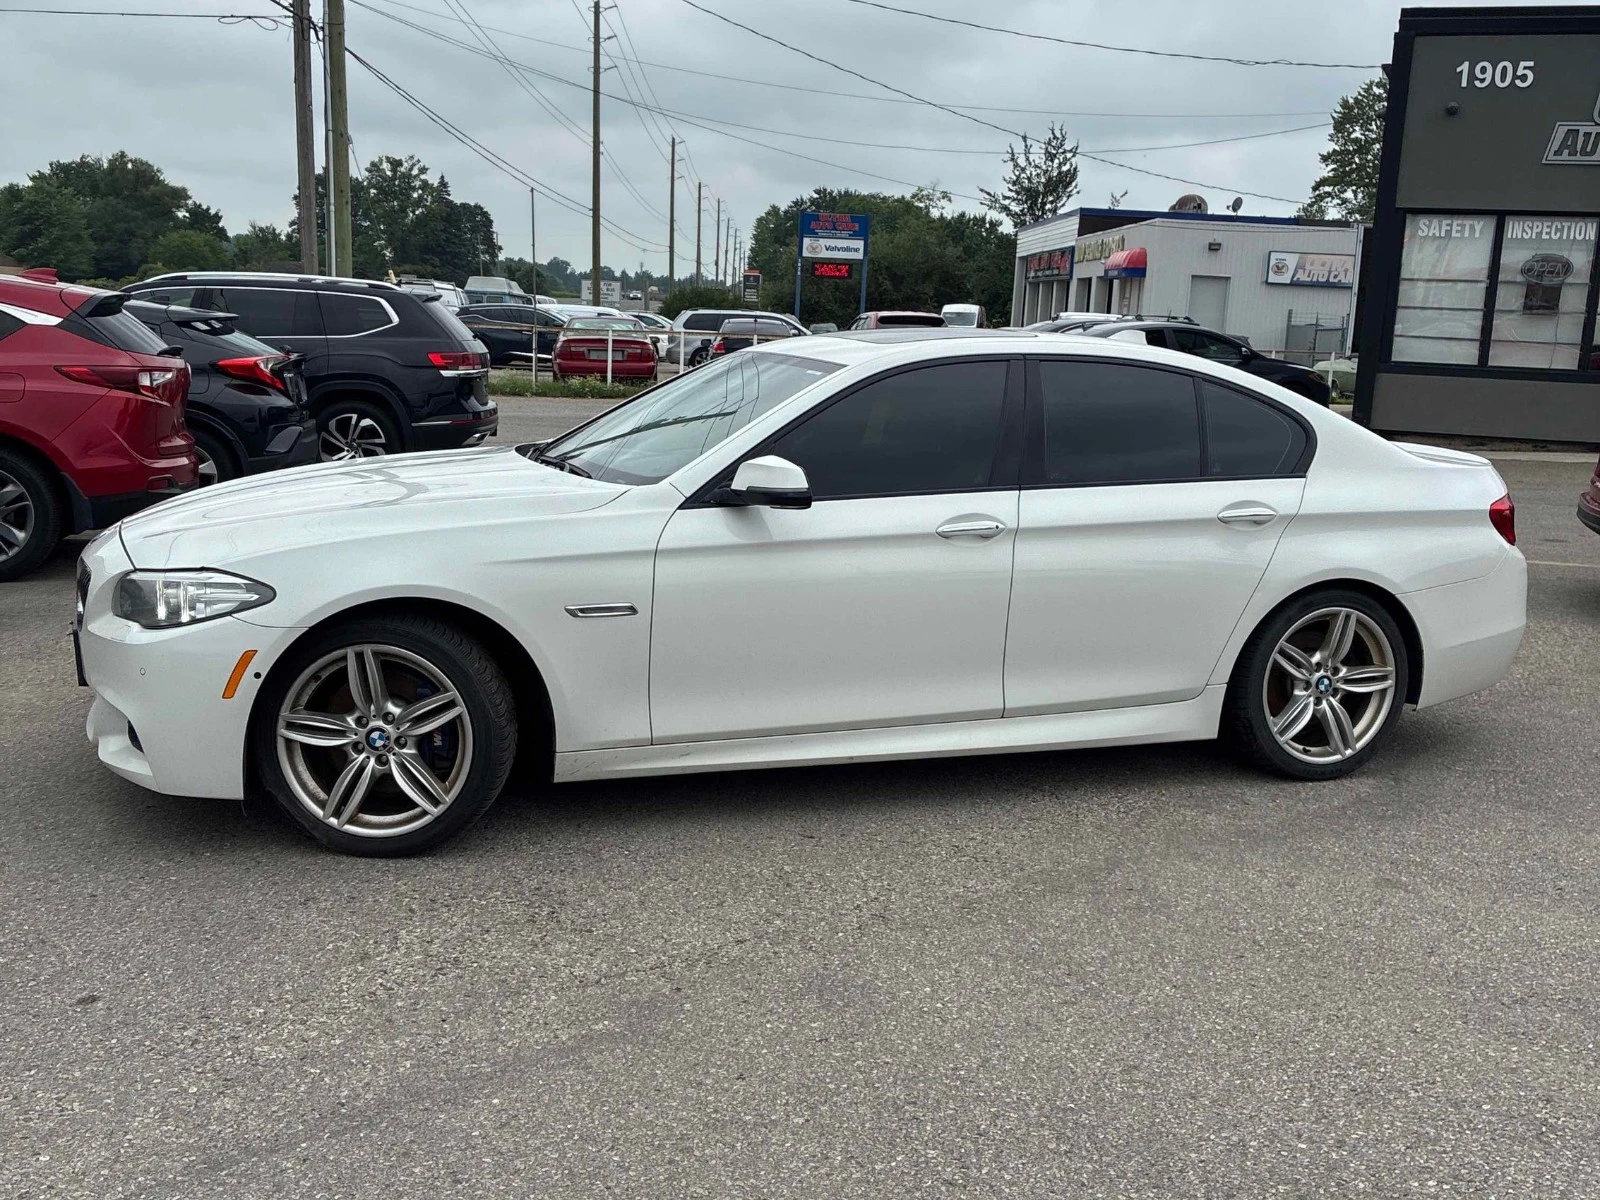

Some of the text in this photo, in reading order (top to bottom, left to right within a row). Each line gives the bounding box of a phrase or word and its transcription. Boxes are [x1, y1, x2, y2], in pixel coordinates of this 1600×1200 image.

[1456, 61, 1535, 88] 1905
[1553, 129, 1600, 157] AU
[1418, 219, 1597, 240] SAFETY INSPECTION
[824, 244, 860, 253] Valvoline
[1525, 261, 1568, 277] OPEN
